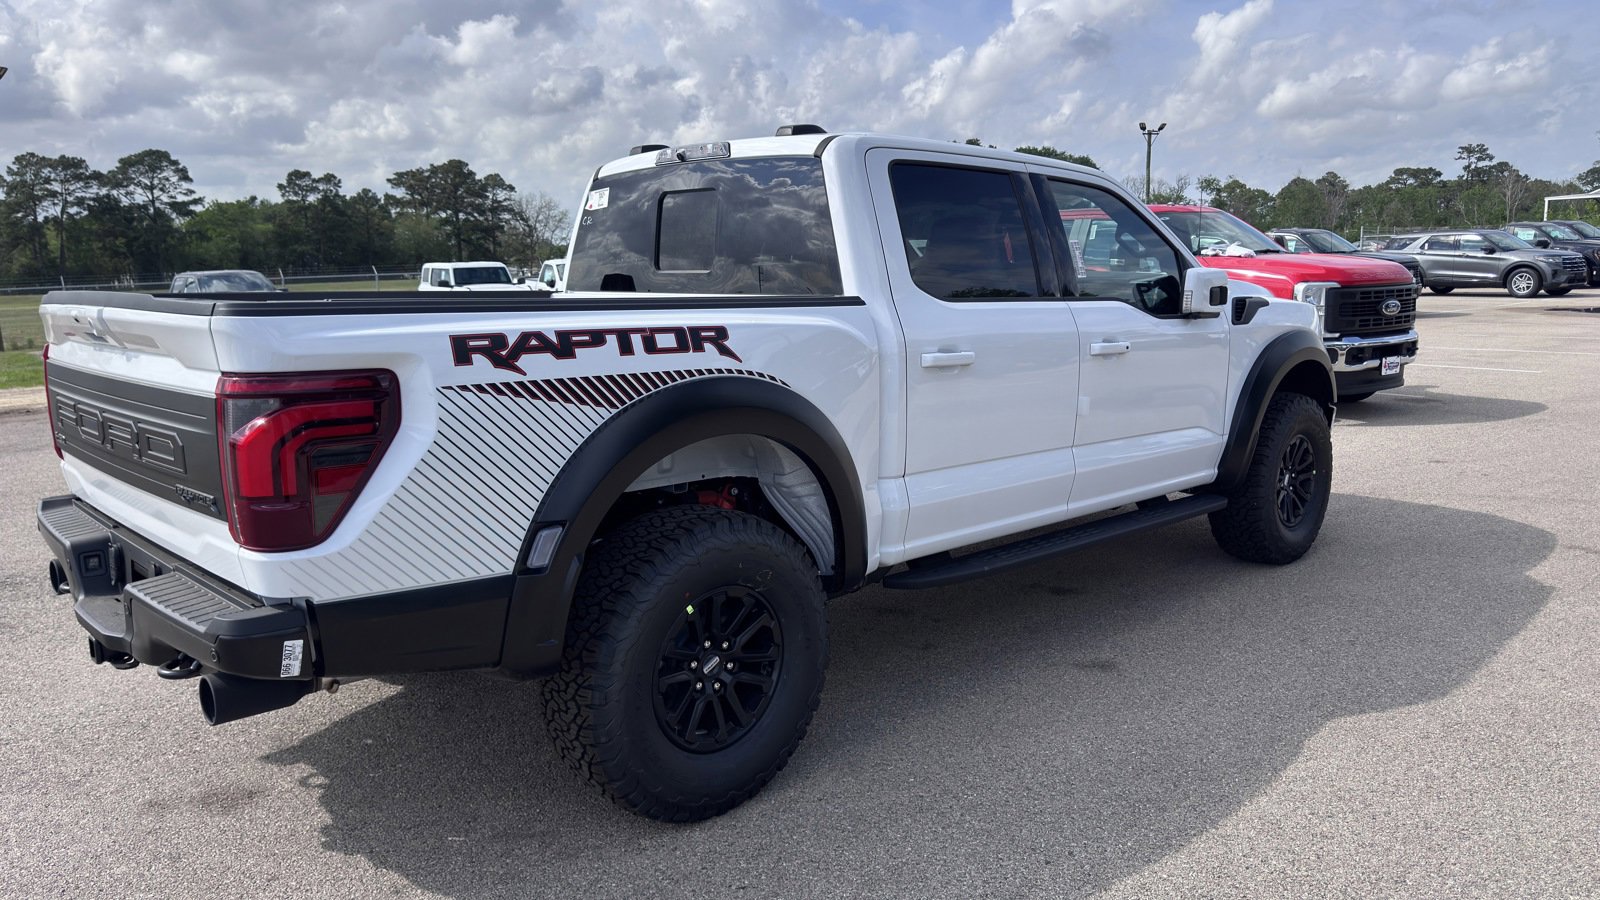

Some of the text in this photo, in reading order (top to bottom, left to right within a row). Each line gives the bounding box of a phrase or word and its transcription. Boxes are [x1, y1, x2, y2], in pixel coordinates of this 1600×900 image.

[449, 325, 743, 376] RAPTOR
[56, 395, 188, 474] FORD
[283, 644, 293, 662] 3077
